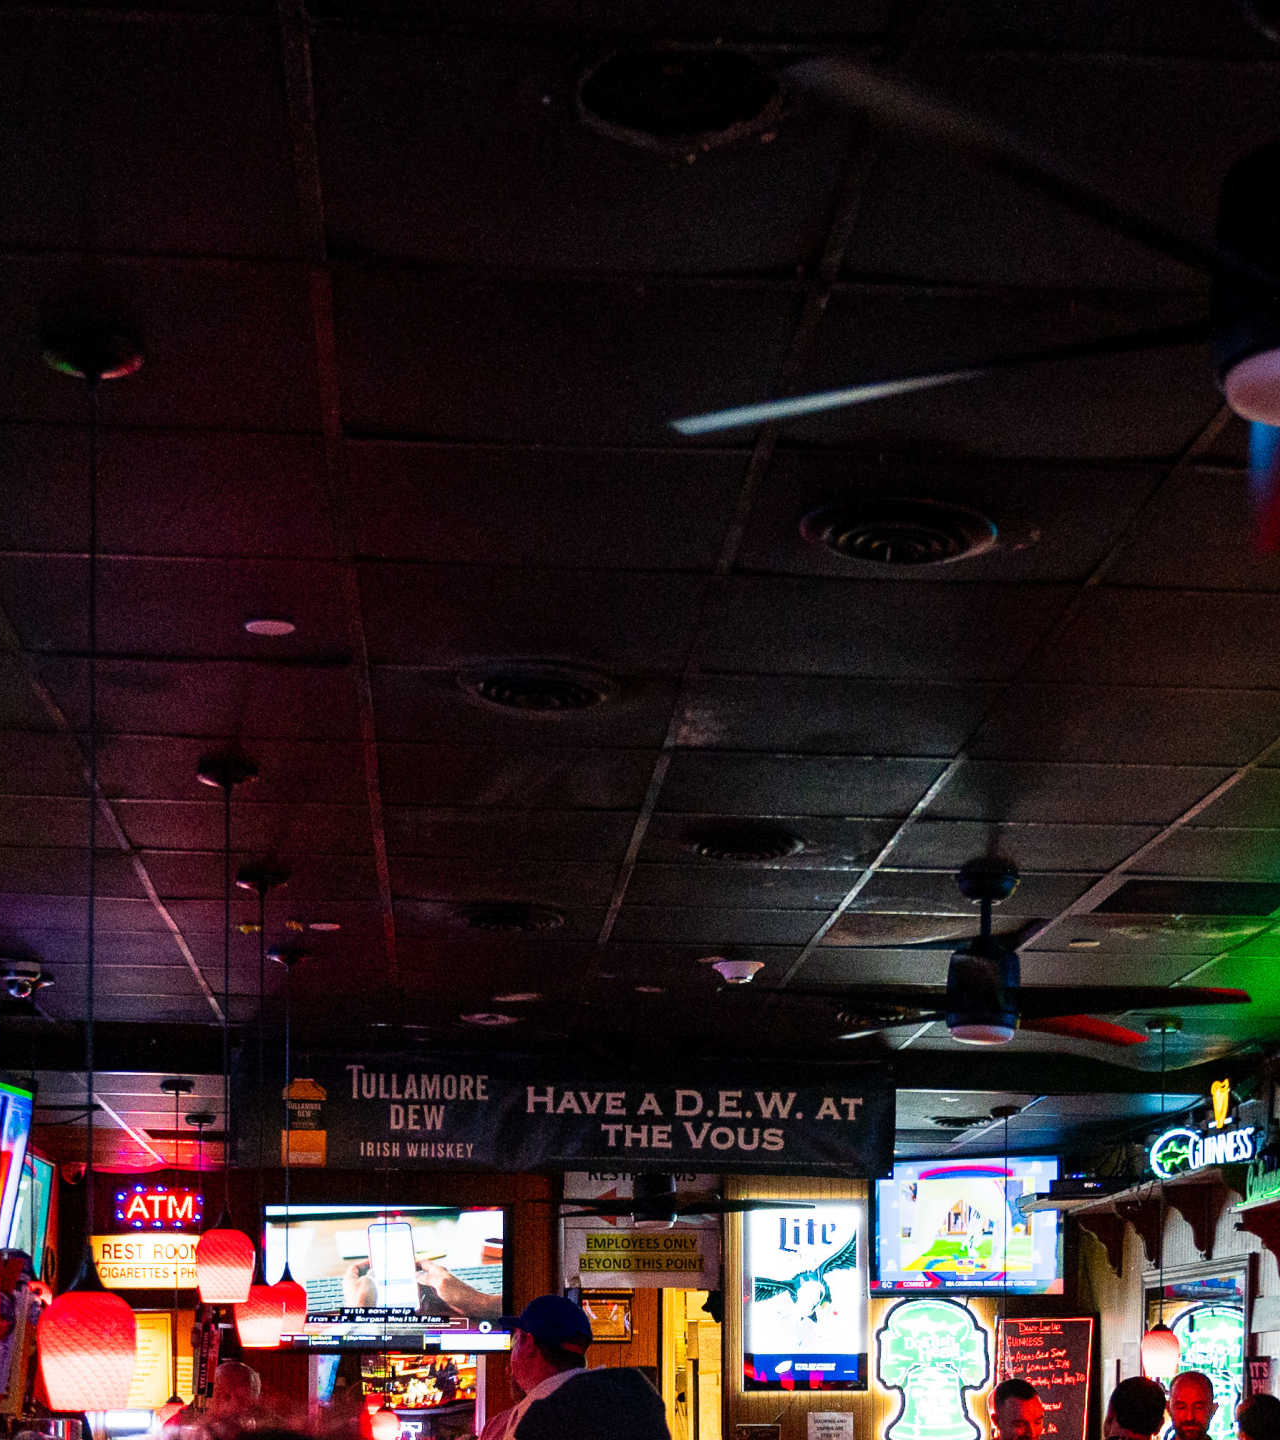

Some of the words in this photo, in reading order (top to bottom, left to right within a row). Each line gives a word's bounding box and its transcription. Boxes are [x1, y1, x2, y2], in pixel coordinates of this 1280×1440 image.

[346, 1064, 489, 1101] TULLAMORE
[526, 1086, 623, 1116] HAVE
[638, 1094, 662, 1117] A
[674, 1090, 803, 1120] D.E.W.
[815, 1096, 863, 1122] AT
[389, 1104, 446, 1131] DEW
[359, 1141, 401, 1158] IRISH
[406, 1141, 475, 1159] WHISKEY
[600, 1123, 673, 1148] THE
[687, 1122, 785, 1152] VOUS
[1187, 1126, 1256, 1170] GUINNESS
[126, 1194, 194, 1219] ATM
[586, 1237, 660, 1250] EMPLOYEES
[663, 1237, 698, 1249] ONLY
[778, 1217, 836, 1253] Lite
[101, 1242, 144, 1260] REST
[579, 1257, 632, 1271] BEYOND
[635, 1257, 663, 1270] THIS
[666, 1257, 705, 1270] POINT
[99, 1266, 170, 1279] CIGARETTES
